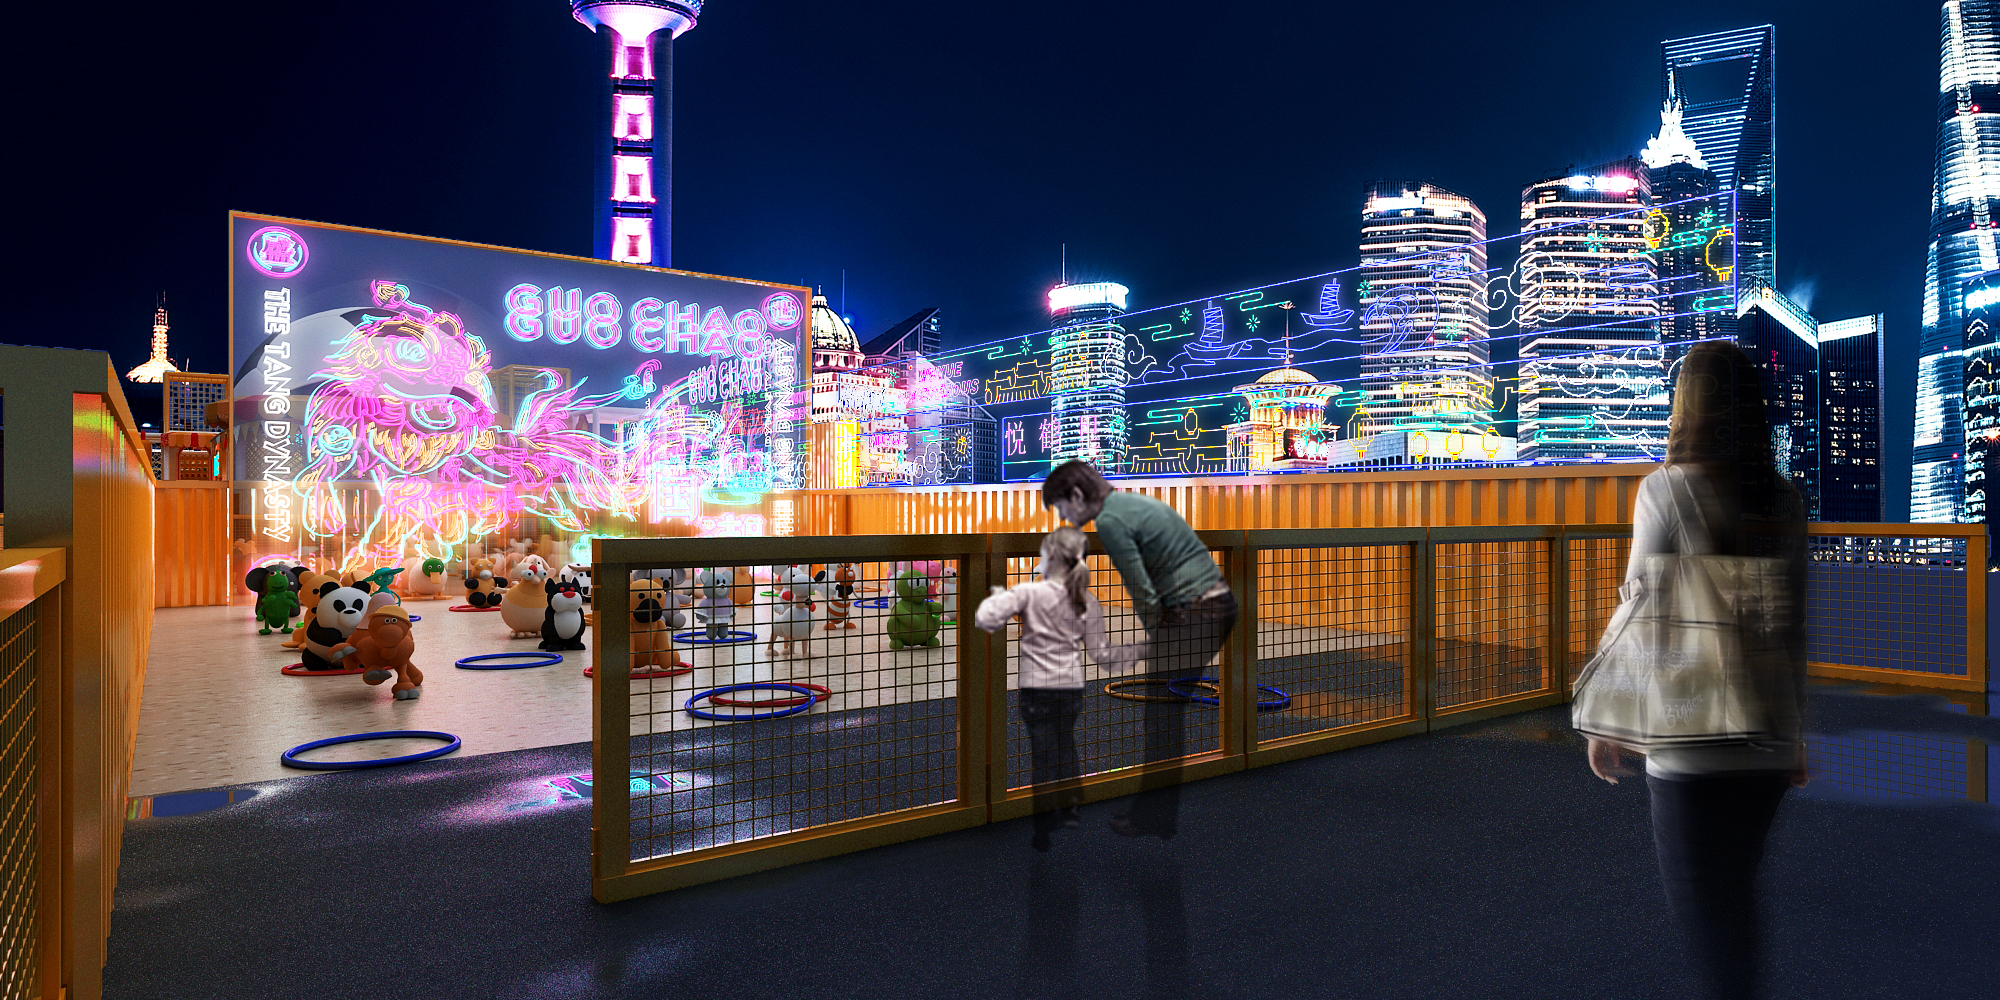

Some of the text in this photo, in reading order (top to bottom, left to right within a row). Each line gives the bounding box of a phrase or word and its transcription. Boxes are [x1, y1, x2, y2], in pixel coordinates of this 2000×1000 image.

[264, 287, 291, 335] THE
[502, 283, 623, 350] GUO
[627, 296, 767, 360] CHAO
[263, 341, 292, 414] TANG
[688, 364, 717, 405] GUO
[773, 338, 795, 433] DYNASTY
[263, 420, 292, 542] DYNASTY
